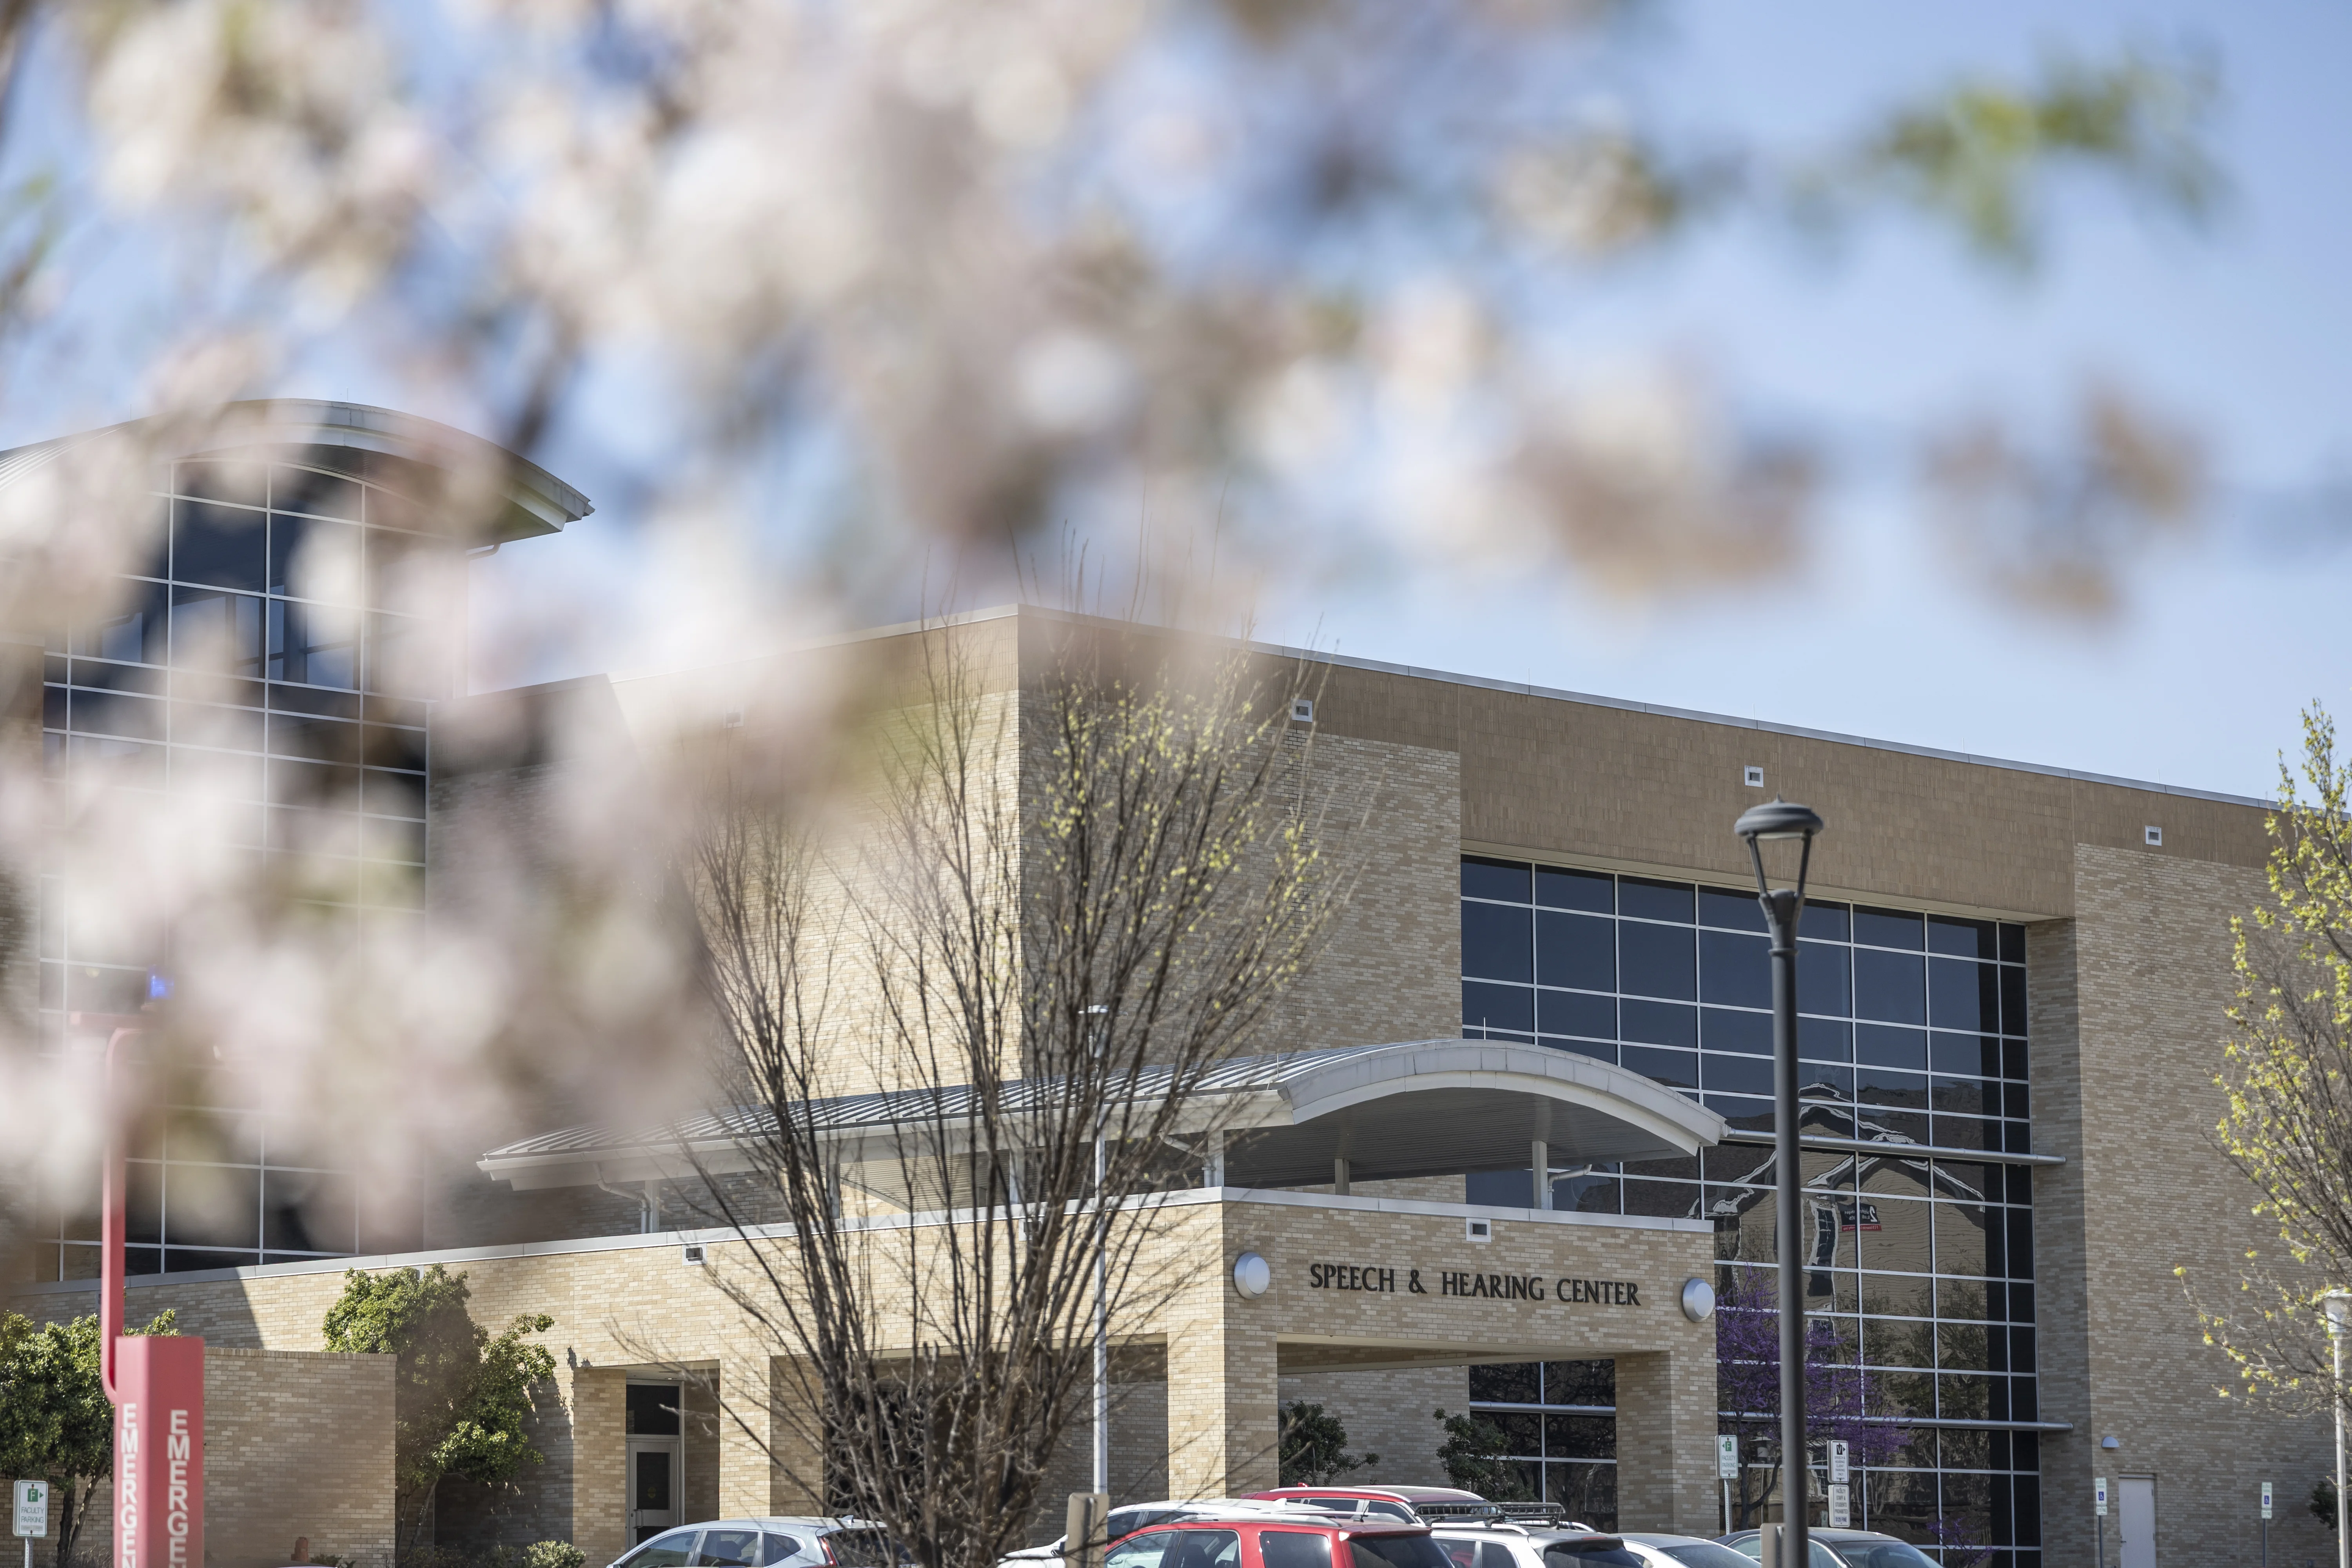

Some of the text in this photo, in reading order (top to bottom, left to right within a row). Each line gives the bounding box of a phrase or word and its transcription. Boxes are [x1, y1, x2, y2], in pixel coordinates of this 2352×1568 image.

[1310, 1263, 1641, 1306] SPEECH & HEARING CENTER
[31, 1490, 36, 1501] F
[167, 1409, 190, 1568] EMERGE
